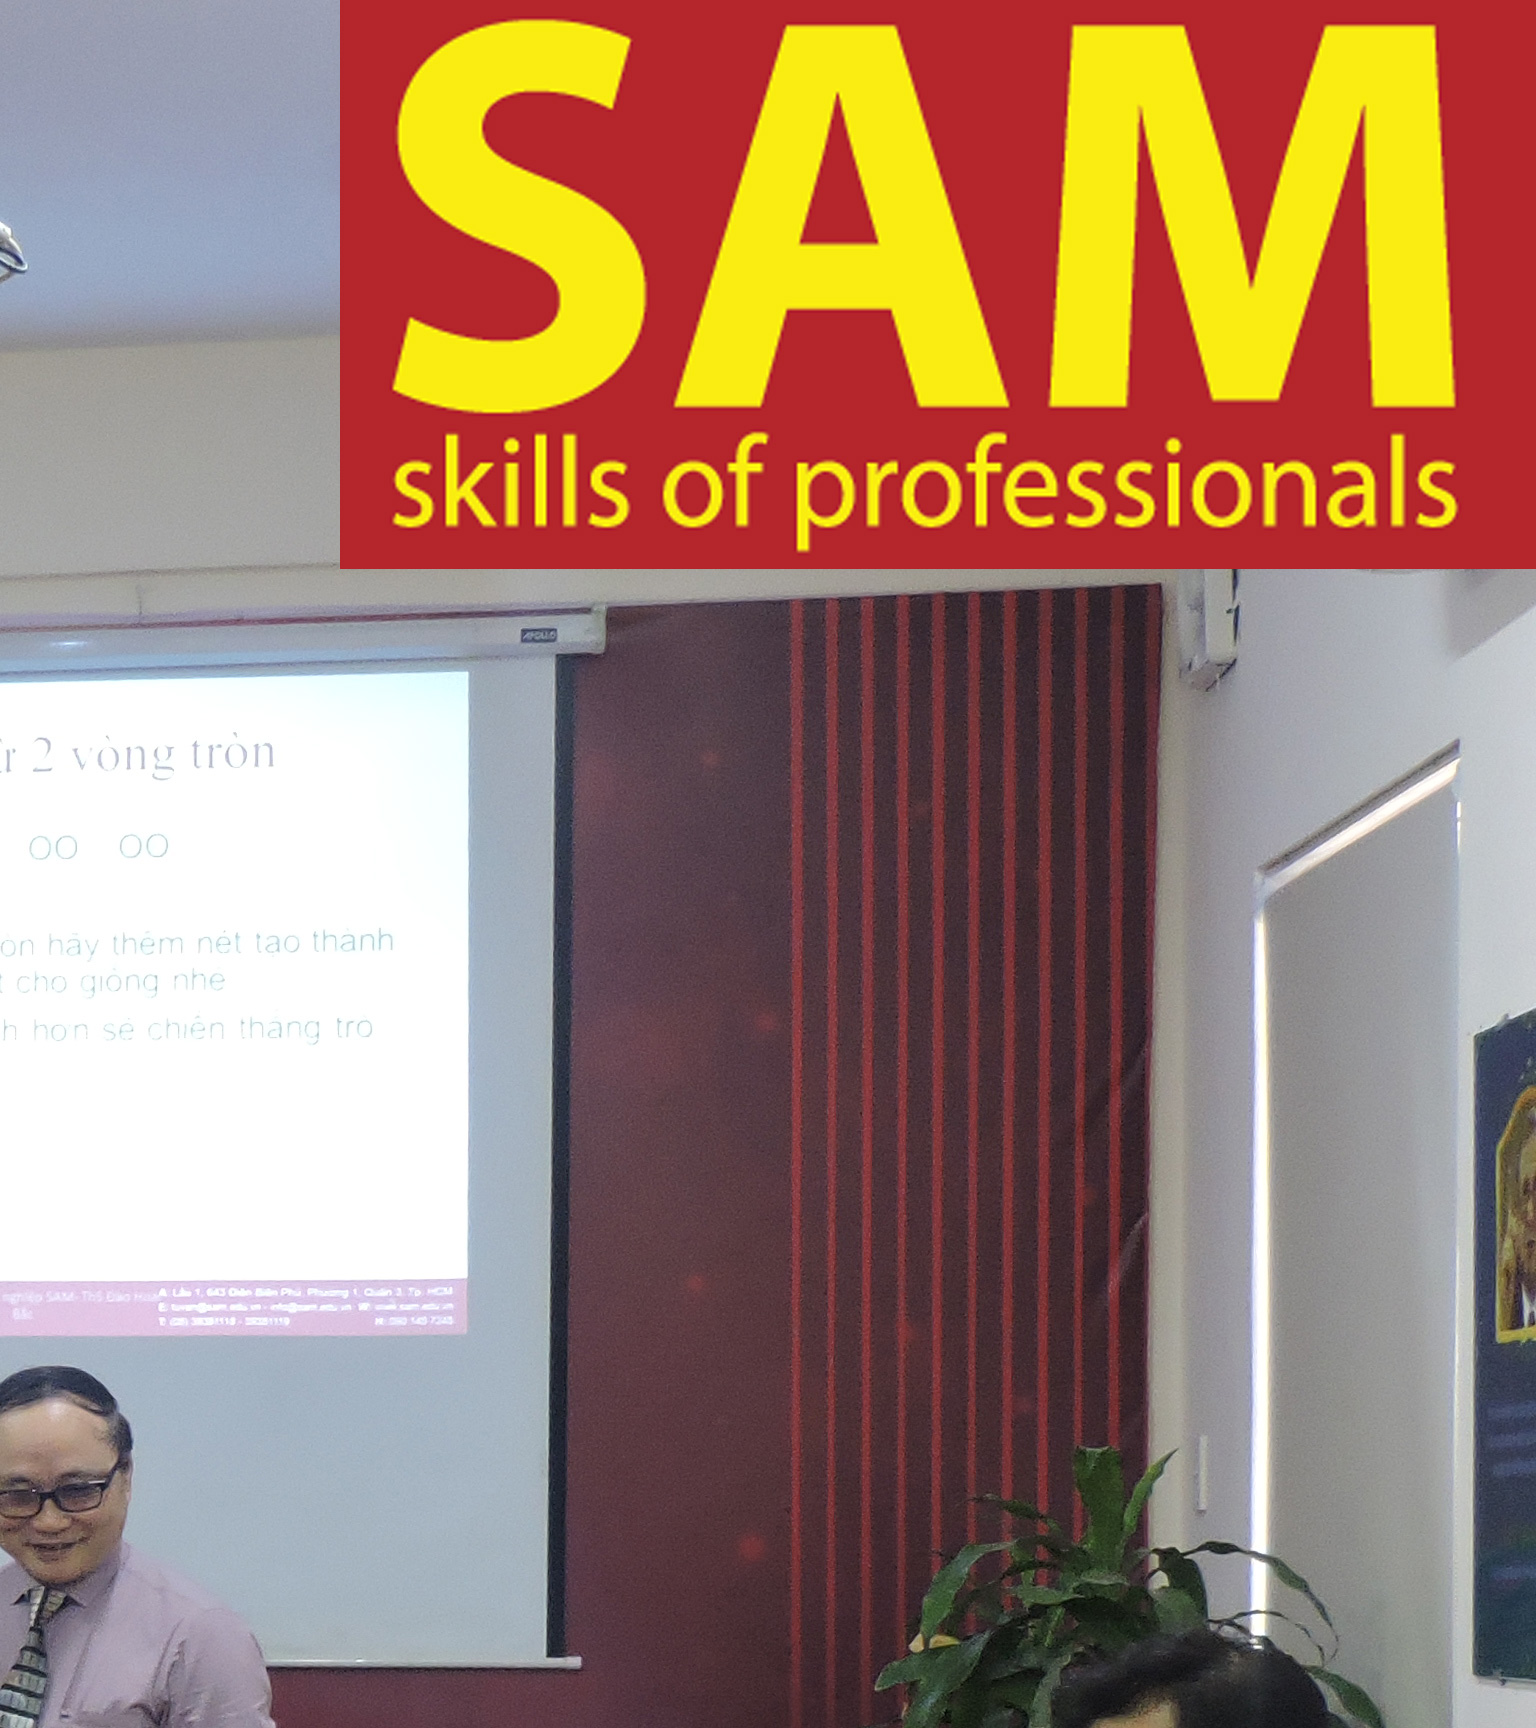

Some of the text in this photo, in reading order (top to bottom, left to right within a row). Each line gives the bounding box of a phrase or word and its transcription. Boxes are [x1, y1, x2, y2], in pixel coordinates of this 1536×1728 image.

[31, 737, 54, 773] 2
[71, 735, 176, 781] vòng
[191, 731, 275, 769] tròn
[16, 970, 68, 993] cho
